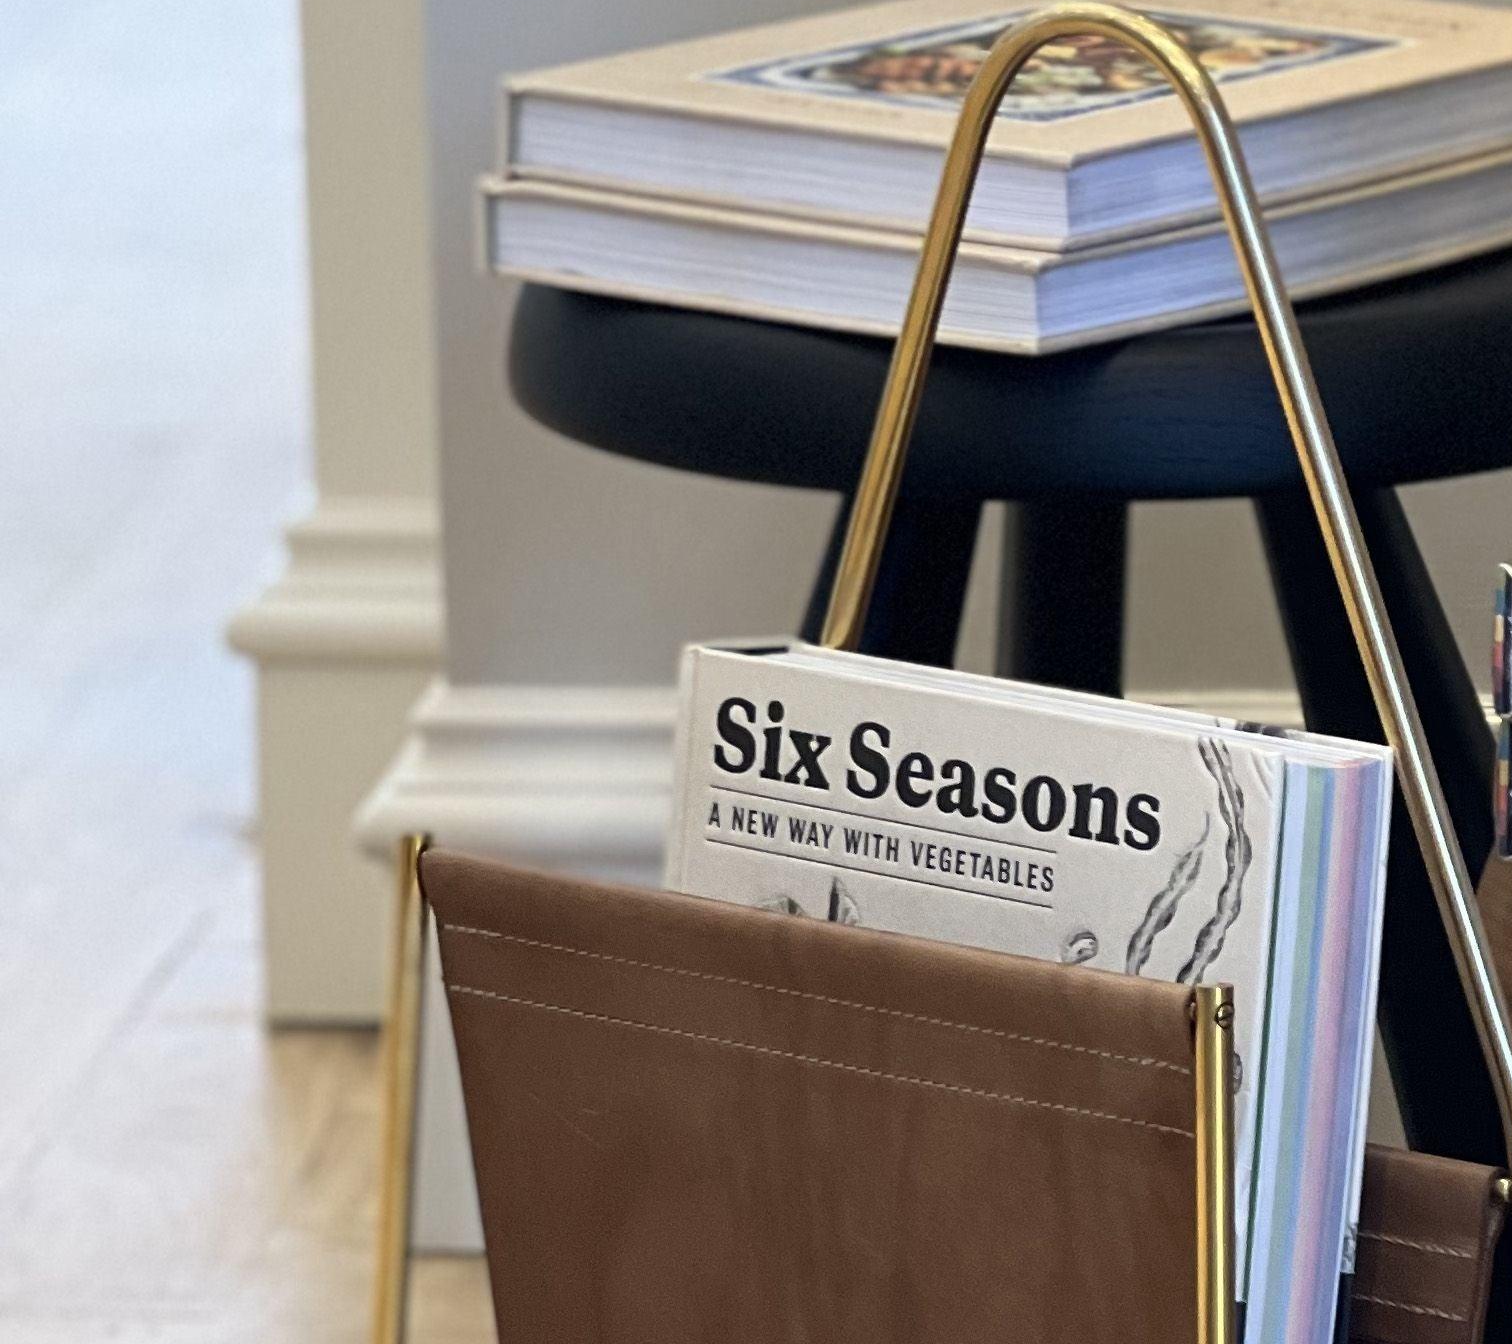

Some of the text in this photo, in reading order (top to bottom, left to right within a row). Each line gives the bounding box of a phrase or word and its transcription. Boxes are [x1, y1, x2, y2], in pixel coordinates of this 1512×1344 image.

[711, 694, 1162, 852] Six Seasons
[707, 801, 1056, 894] A NEW WAY WITH VEGETABLES
